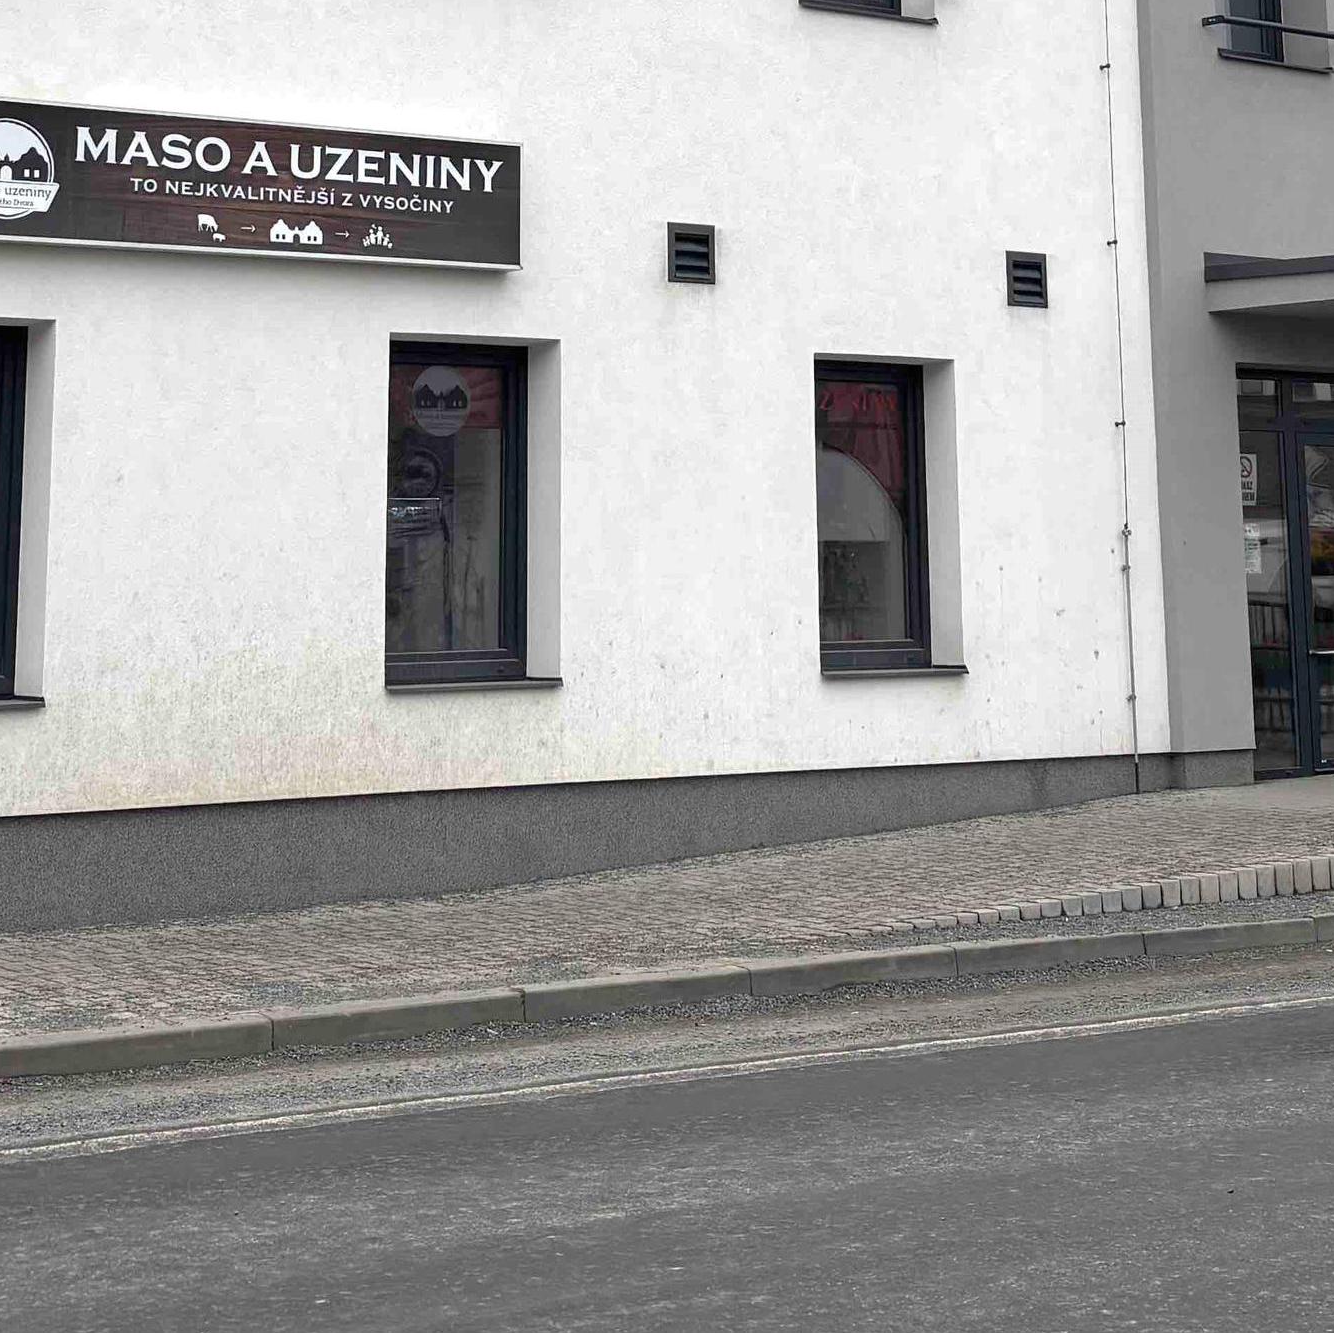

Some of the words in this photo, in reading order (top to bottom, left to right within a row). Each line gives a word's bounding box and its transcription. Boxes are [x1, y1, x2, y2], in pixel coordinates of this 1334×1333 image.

[74, 125, 232, 173] MASO
[241, 140, 279, 177] A
[289, 143, 504, 193] UZENINY
[4, 186, 52, 201] uzeniny
[130, 177, 158, 193] TO
[165, 179, 336, 206] NEJKVALITNĚJŠÍ
[341, 193, 354, 207] Z
[359, 193, 455, 214] VYSOČINY
